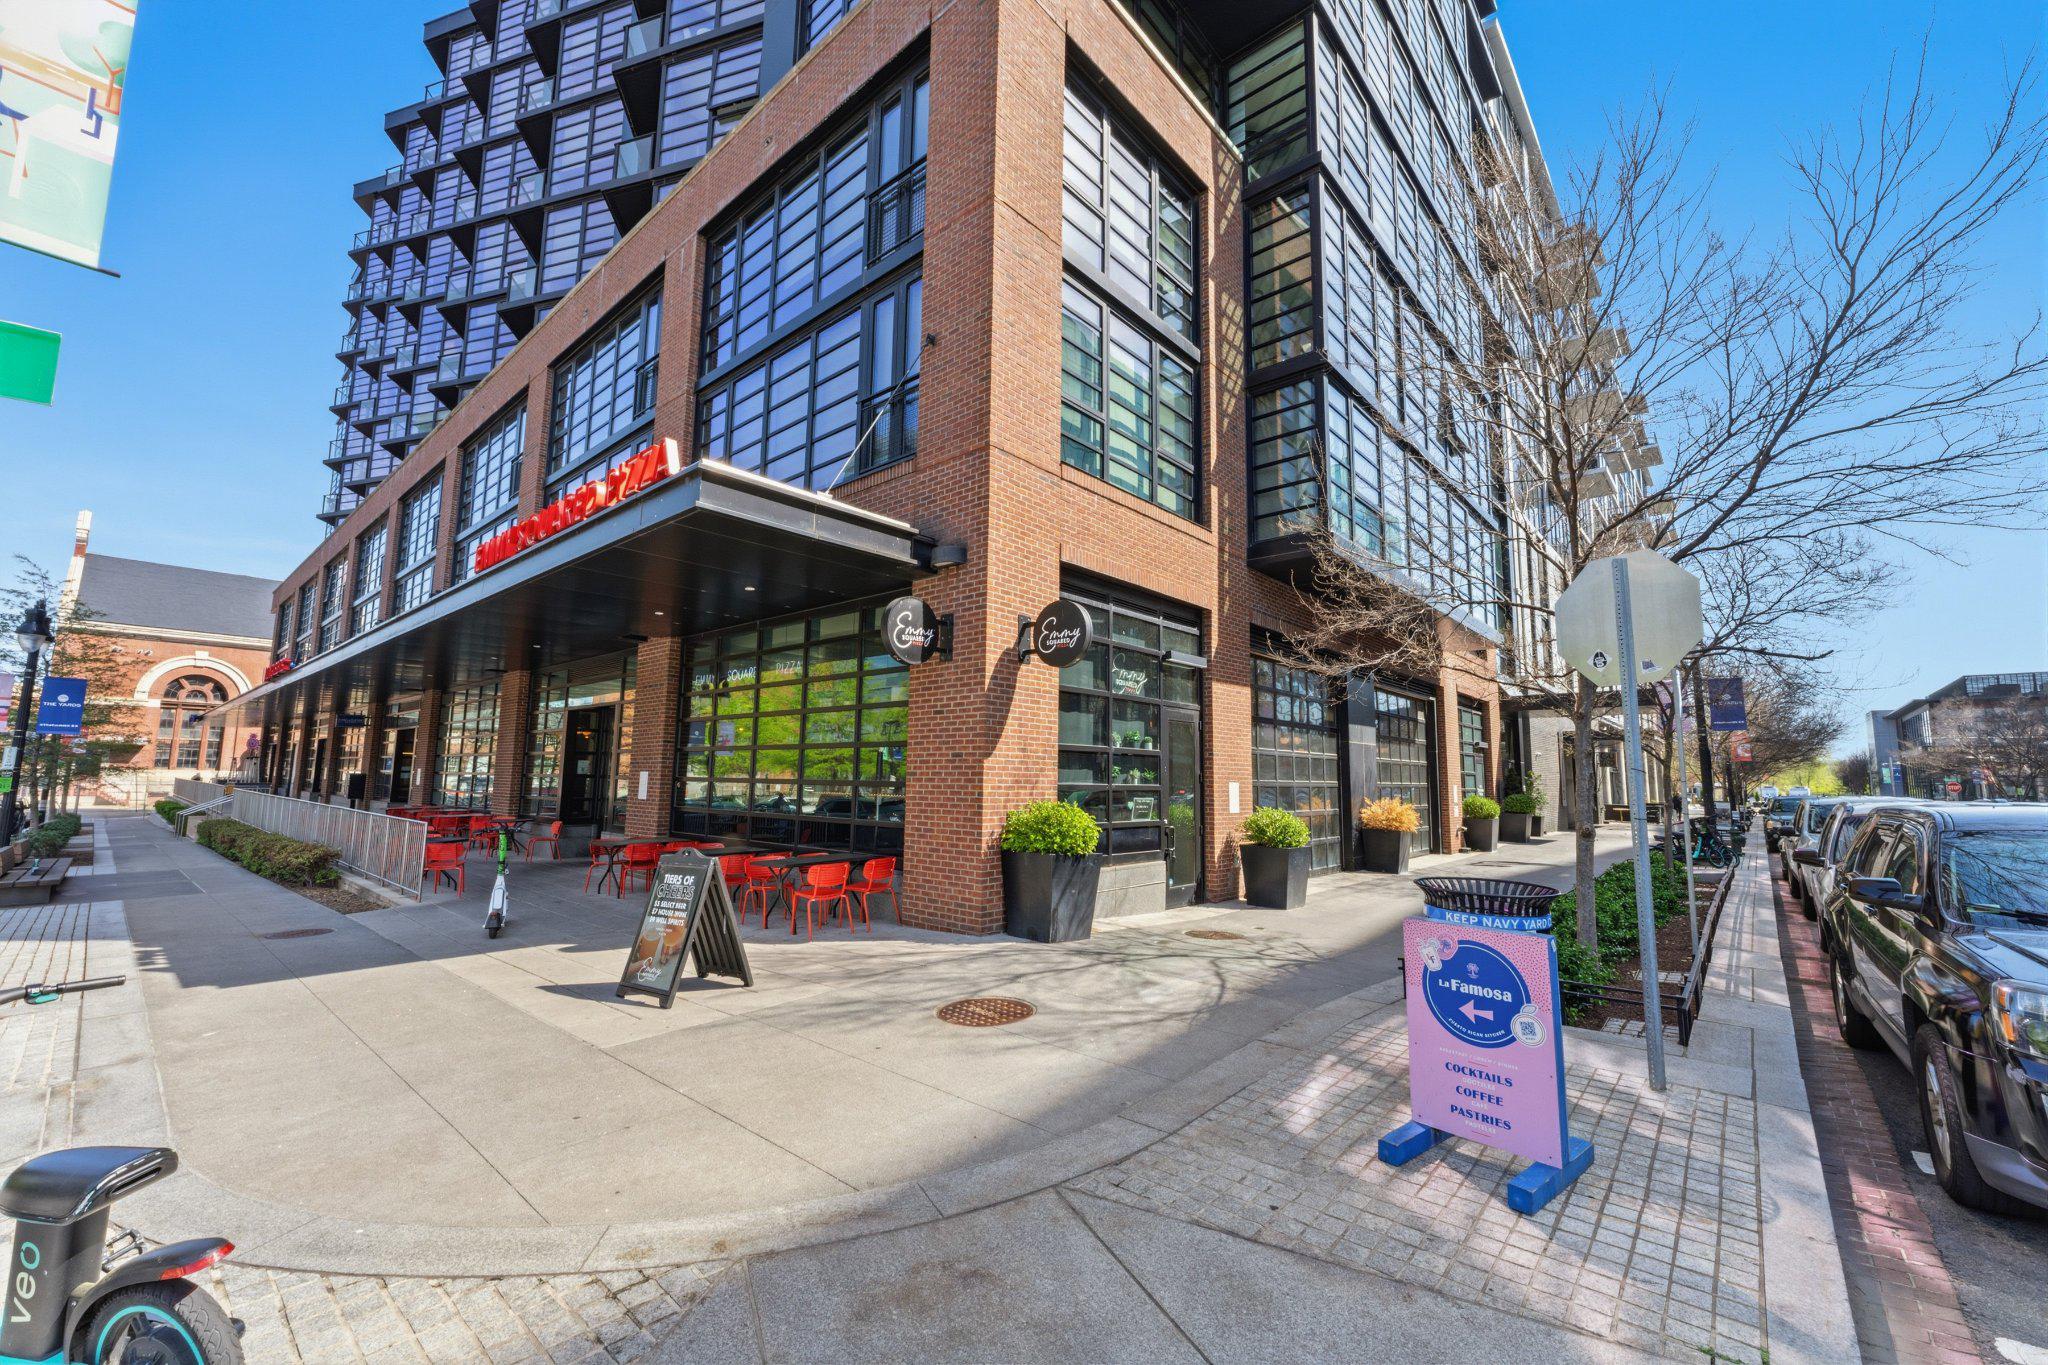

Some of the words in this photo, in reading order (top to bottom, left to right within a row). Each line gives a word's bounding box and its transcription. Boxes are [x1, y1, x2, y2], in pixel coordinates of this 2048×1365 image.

[893, 611, 935, 648] Emmy
[1038, 616, 1081, 653] Emmy
[657, 883, 696, 900] CHEERS
[664, 874, 684, 884] TIERS
[683, 875, 695, 885] OF
[1445, 911, 1479, 925] KEEP
[1482, 917, 1520, 929] NAVY
[1522, 919, 1547, 930] YARD
[1439, 979, 1451, 988] La
[1450, 979, 1512, 1003] Famosa
[1445, 1061, 1513, 1087] COCKTAILS
[1455, 1085, 1504, 1106] COFFEE
[1450, 1104, 1512, 1130] PASTRIES
[11, 1241, 40, 1322] veo
